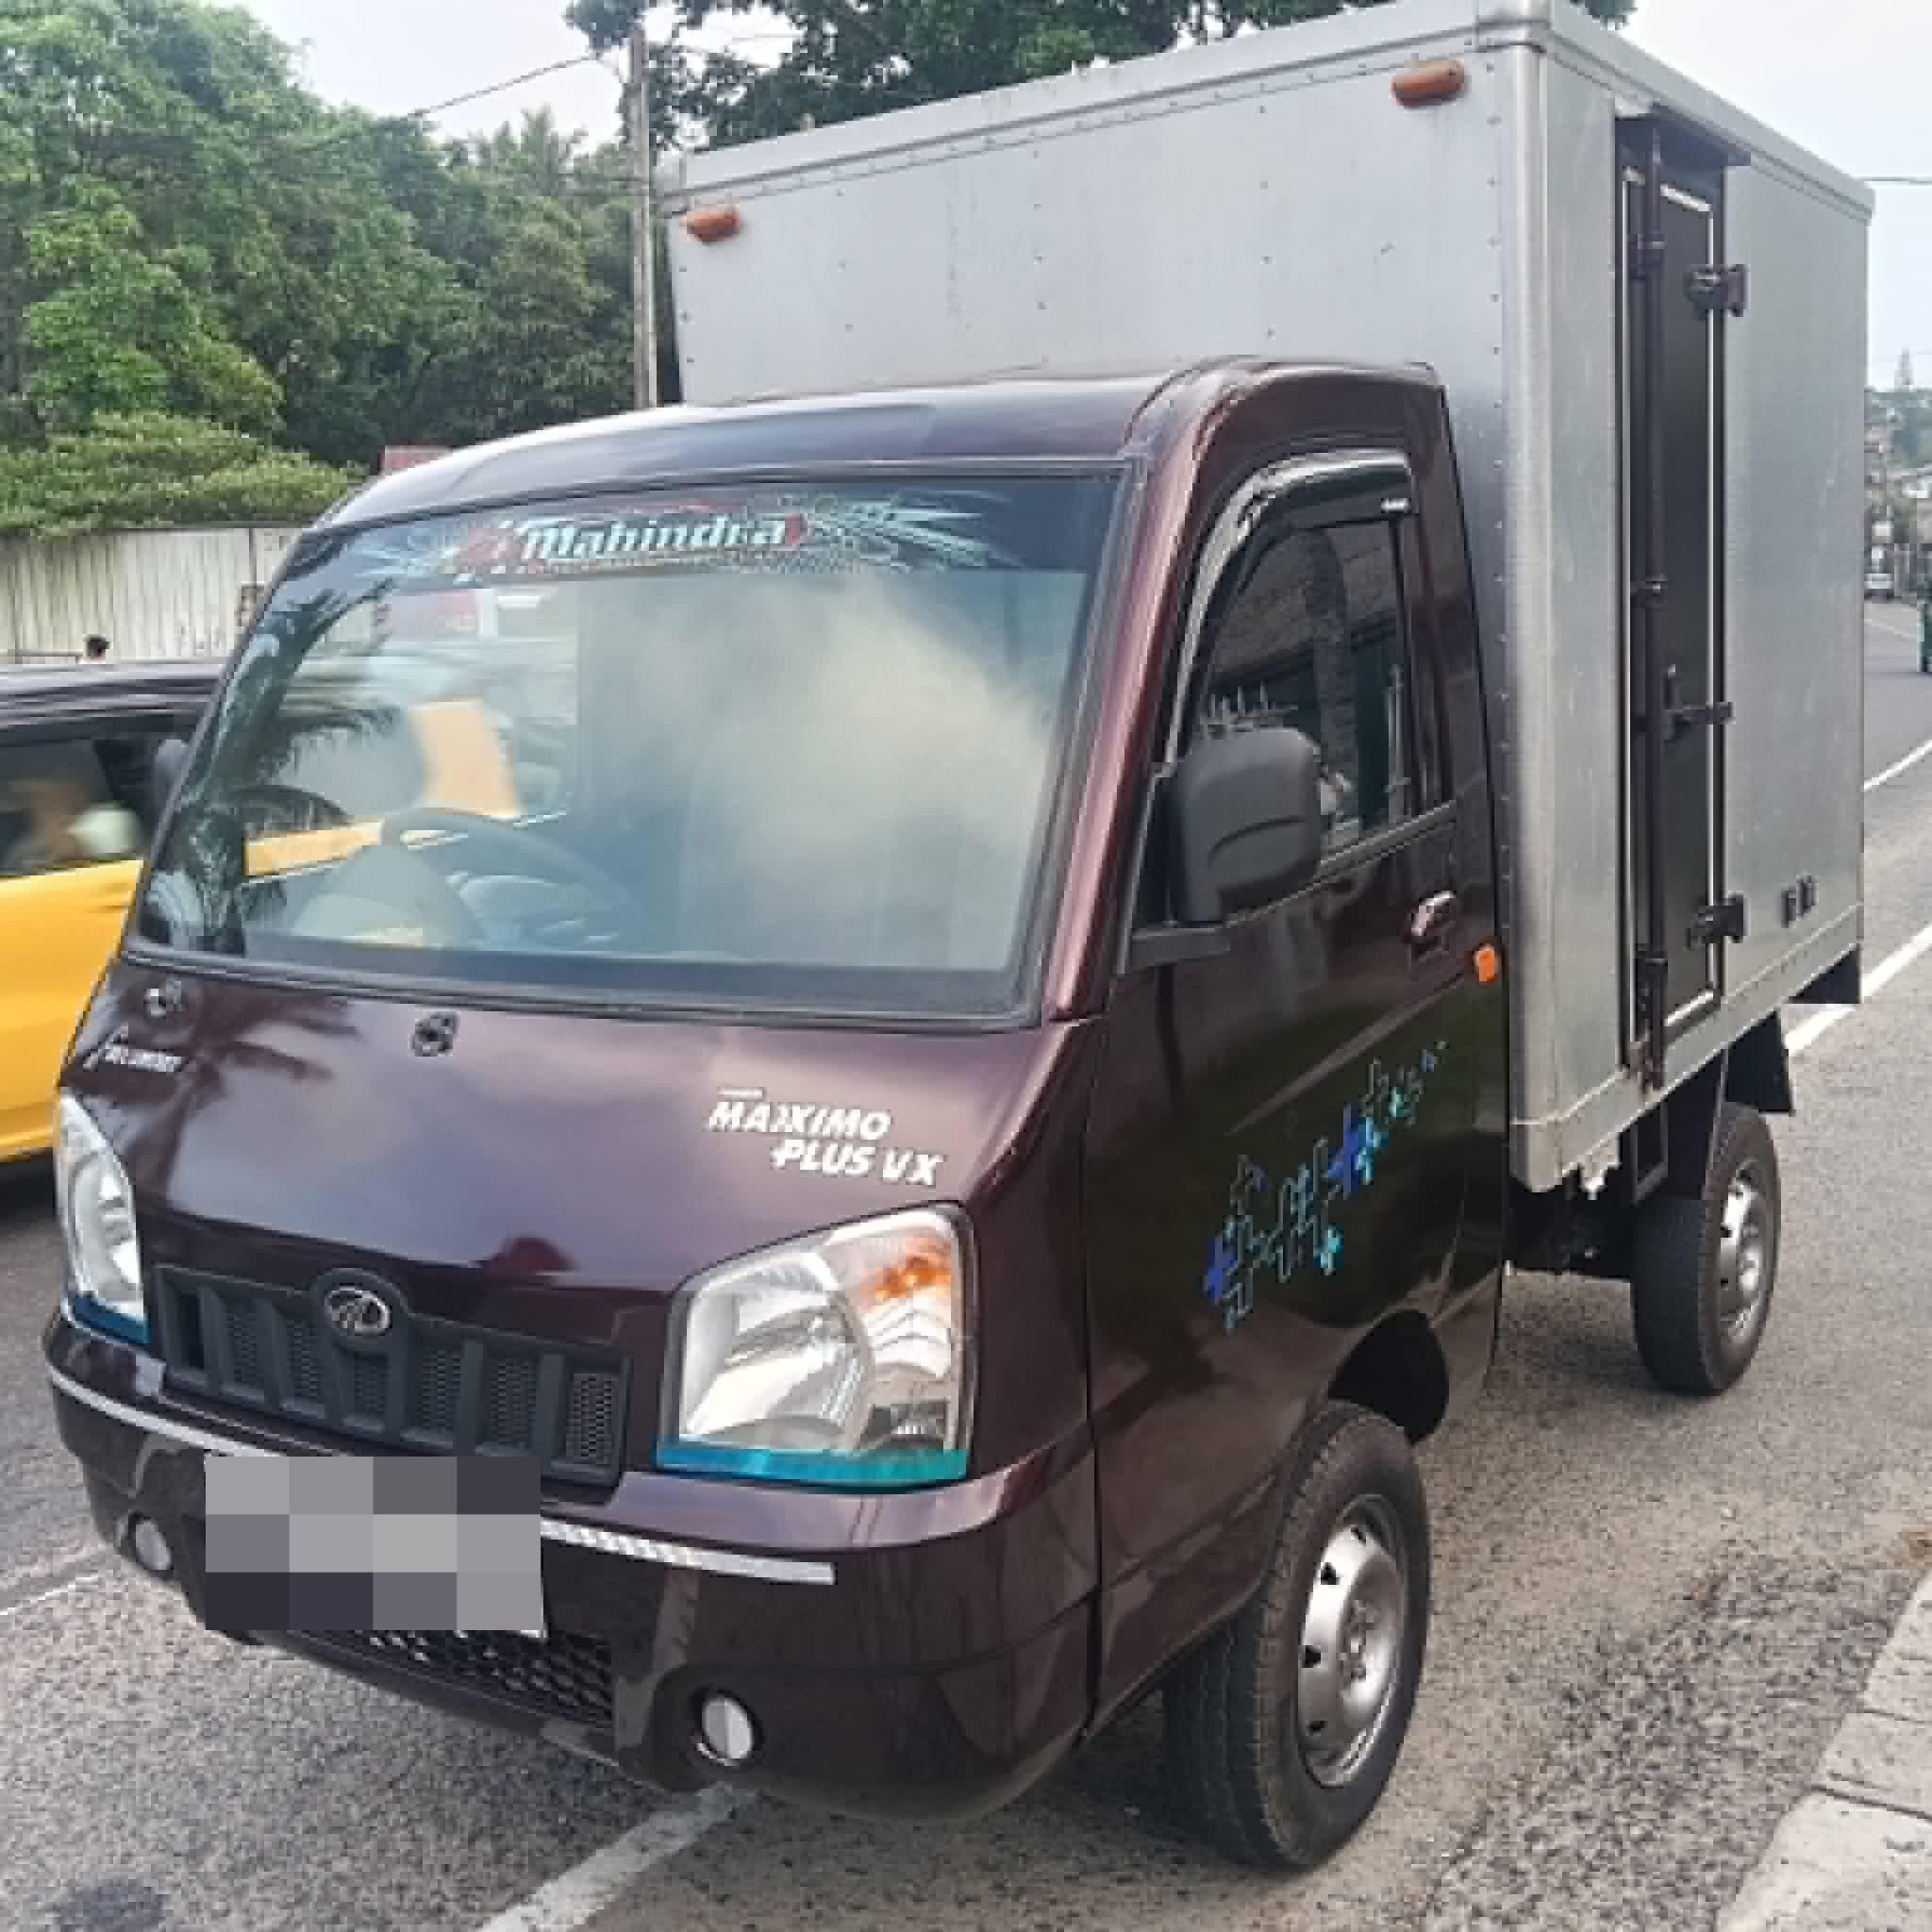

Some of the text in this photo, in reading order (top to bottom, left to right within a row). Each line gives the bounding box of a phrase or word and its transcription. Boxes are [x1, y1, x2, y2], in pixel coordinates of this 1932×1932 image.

[516, 512, 787, 562] Mahindra
[771, 1139, 947, 1186] PLUS VX
